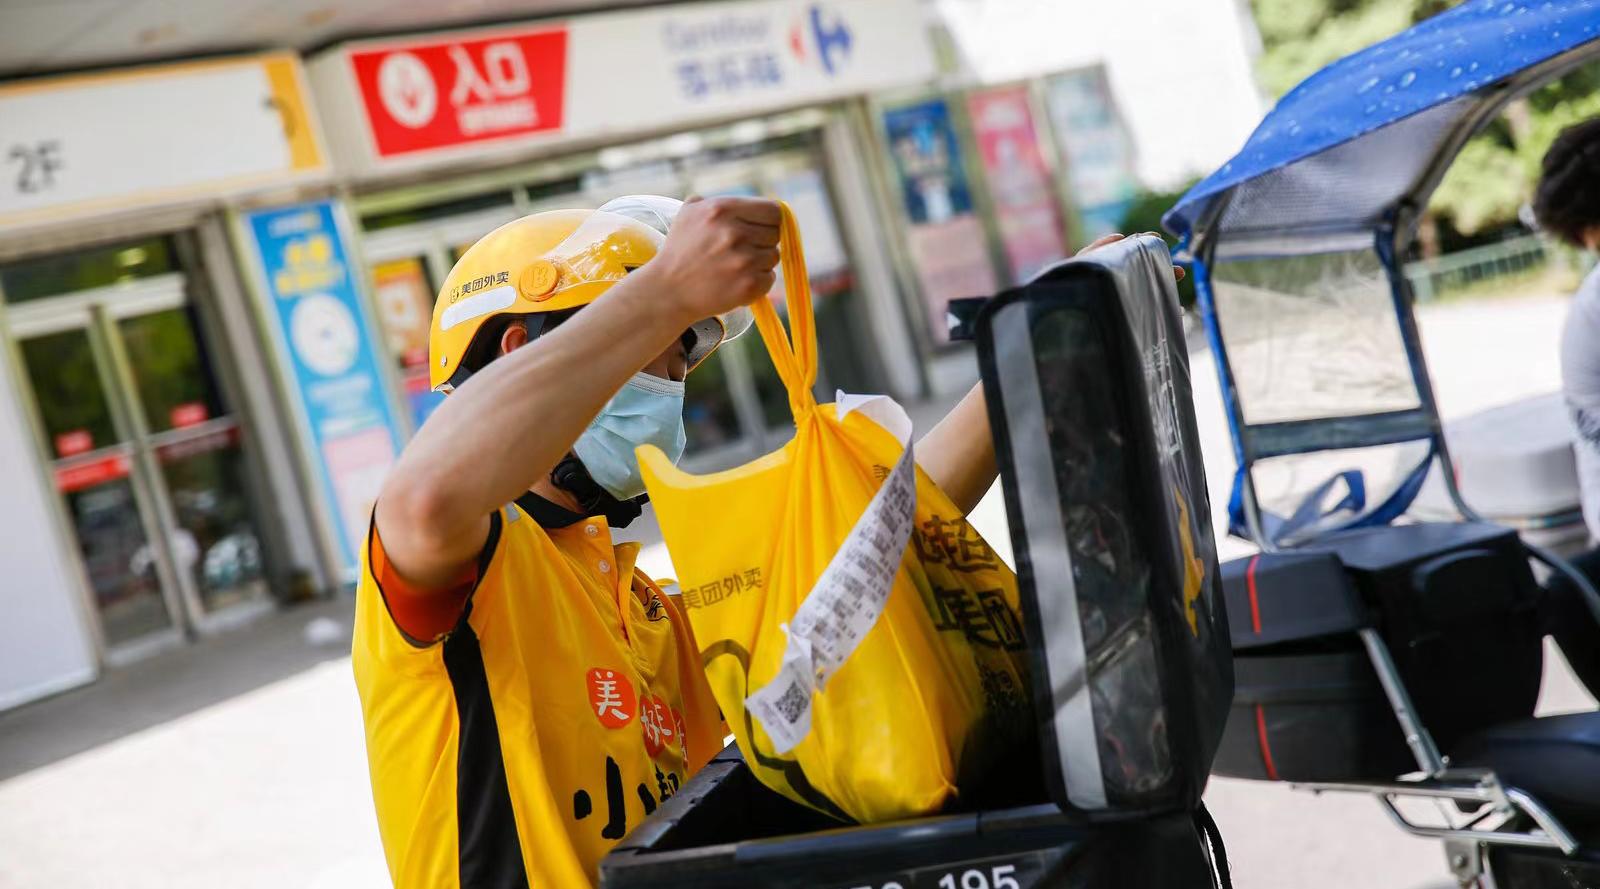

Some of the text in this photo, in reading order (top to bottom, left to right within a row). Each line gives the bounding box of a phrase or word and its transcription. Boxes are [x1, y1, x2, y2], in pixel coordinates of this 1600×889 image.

[449, 41, 531, 106] 入口
[6, 141, 66, 193] 2F
[461, 270, 510, 296] 美团外卖
[681, 566, 764, 611] 美团外卖
